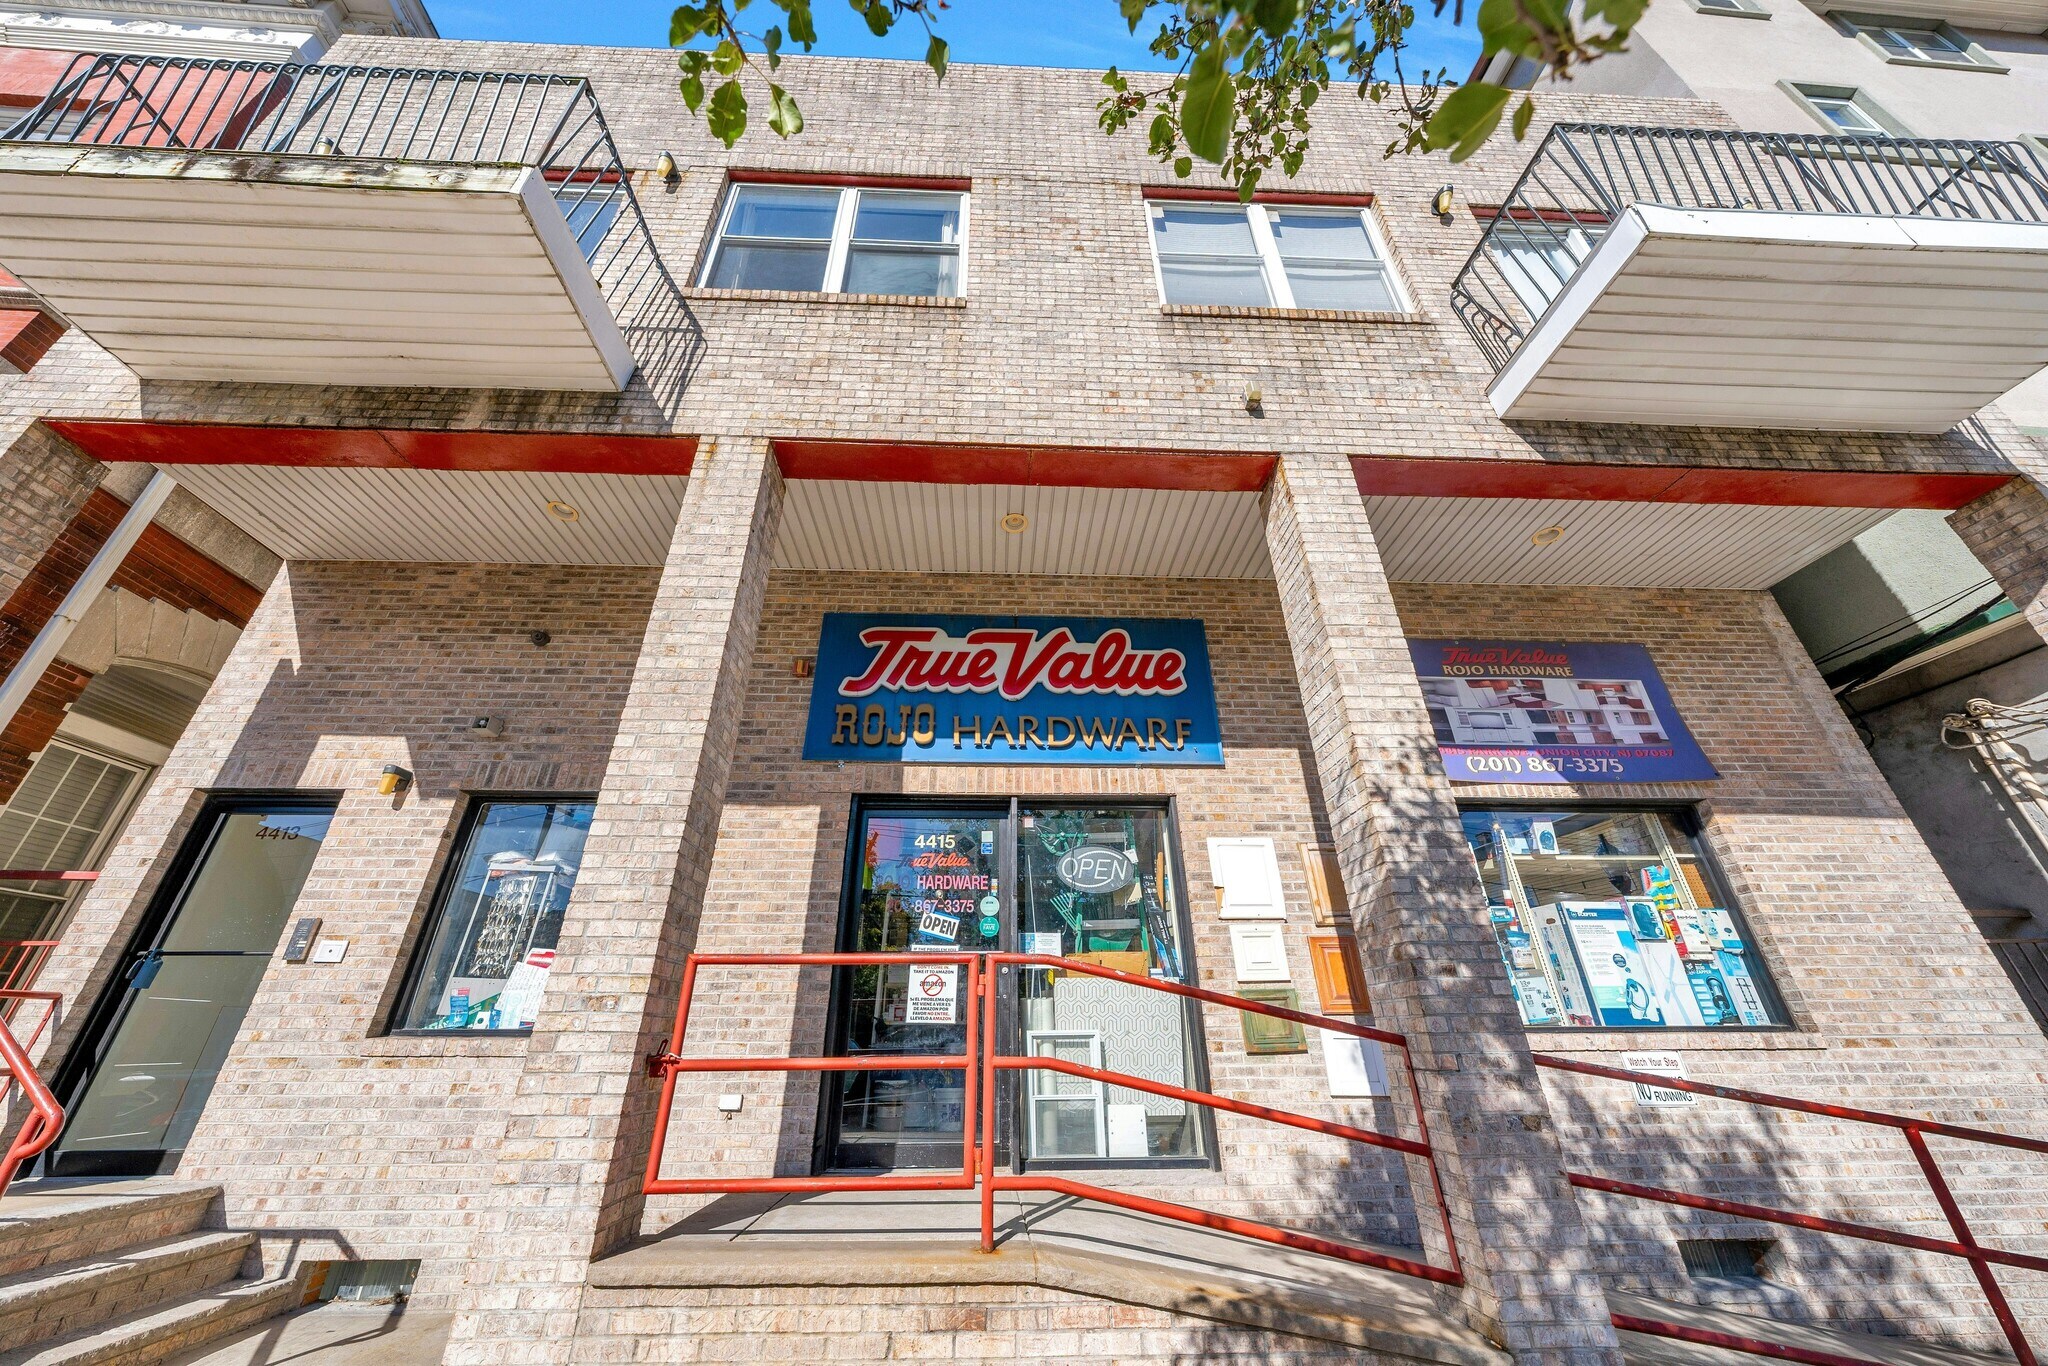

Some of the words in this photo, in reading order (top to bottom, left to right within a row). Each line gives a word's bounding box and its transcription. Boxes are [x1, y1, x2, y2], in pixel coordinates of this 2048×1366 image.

[842, 630, 998, 692] True
[966, 629, 1185, 696] Value
[1442, 647, 1499, 665] True
[1484, 647, 1569, 665] Value
[1442, 664, 1485, 676] ROJO
[1487, 664, 1574, 677] HARDWARE
[831, 703, 938, 746] ROJO
[1534, 748, 1582, 758] UNION
[1617, 748, 1633, 759] NJ
[1634, 748, 1675, 758] 07087
[1466, 756, 1522, 774] (201)
[1527, 757, 1625, 774] 867-3375
[255, 826, 301, 840] 4413
[914, 834, 956, 849] 4415
[1061, 857, 1128, 881] OPEN
[916, 874, 989, 890] HARDWARE
[922, 914, 957, 937] OPEN
[1627, 1057, 1648, 1067] Watch
[1648, 1057, 1662, 1067] Your
[1664, 1057, 1679, 1068] Step
[1635, 1082, 1652, 1101] NO
[1653, 1090, 1694, 1102] RUNNING
